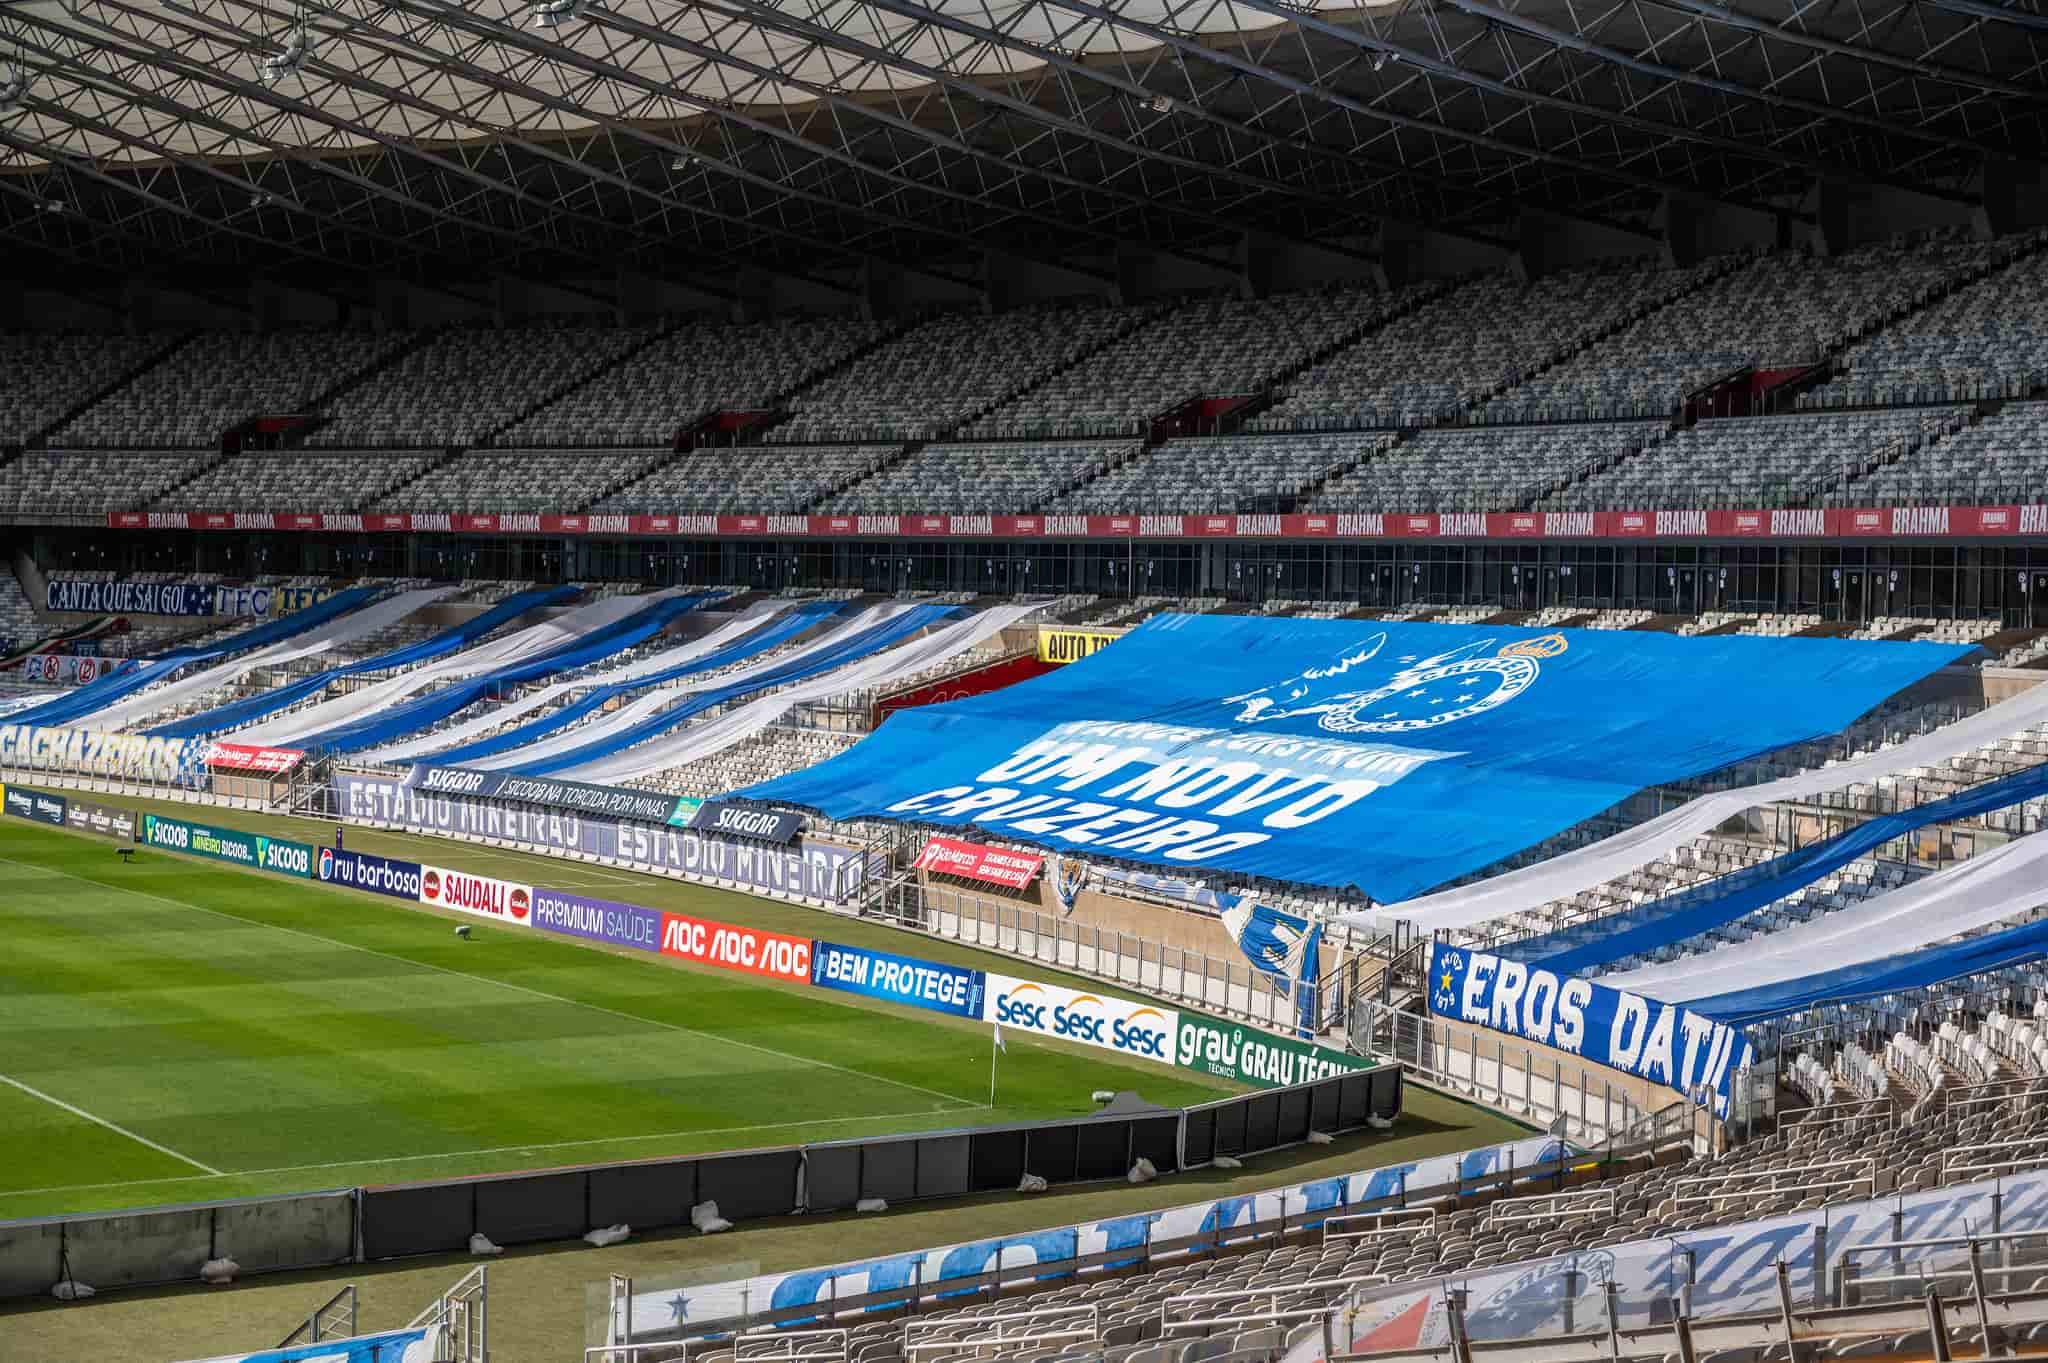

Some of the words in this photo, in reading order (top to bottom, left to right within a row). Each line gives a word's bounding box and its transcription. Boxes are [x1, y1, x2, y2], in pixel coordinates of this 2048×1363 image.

[148, 512, 190, 528] BRAHMA
[234, 512, 275, 529] BRAHMA
[322, 514, 362, 532] BRAHMA
[411, 514, 451, 531] BRAHMA
[500, 515, 540, 532] BRAHMA
[588, 515, 629, 533] BRAHMA
[678, 516, 718, 534] BRAHMA
[767, 515, 808, 534] BRAHMA
[858, 516, 900, 534] BRAHMA
[950, 515, 992, 534] BRAHMA
[1045, 515, 1088, 534] BRAHMA
[1139, 515, 1183, 535] BRAHMA
[1236, 515, 1281, 535] BRAHMA
[1337, 515, 1383, 536] BRAHMA
[1440, 514, 1487, 536] BRAHMA
[1544, 513, 1594, 536] BRAHMA
[1655, 511, 1707, 535] BRAHMA
[1771, 510, 1824, 535] BRAHMA
[1892, 507, 1949, 534] BRAHMA
[48, 582, 100, 610] CANTA
[103, 583, 133, 611] QUE
[161, 586, 187, 614] GOL
[1049, 634, 1086, 660] AUTO
[423, 769, 484, 791] SUGGAR
[975, 740, 1151, 792] UM
[1099, 755, 1382, 829] NOVO
[505, 779, 543, 798] SICOOB
[544, 784, 562, 801] NA
[563, 787, 606, 809] TORCIDA
[607, 794, 631, 811] POR
[632, 797, 668, 817] MINAS
[155, 821, 188, 848] SICOOB
[715, 808, 780, 835] SUGGAR
[885, 785, 1273, 861] CRUZEIRO
[192, 836, 220, 854] MINEIRO
[221, 840, 248, 858] SICOOB
[267, 844, 308, 873] SICOOB
[335, 859, 352, 880] rui
[357, 862, 420, 896] barbosa
[445, 875, 505, 915] SAUDALI
[606, 908, 655, 945] SAÚDE
[663, 919, 705, 957] AOC
[710, 923, 756, 967] AOC
[759, 938, 808, 977] AOC
[826, 950, 870, 985] BEM
[871, 959, 969, 1006] PROTEGE
[996, 993, 1046, 1031] Sesc
[1461, 952, 1595, 1055] EROS
[1053, 1005, 1105, 1043] Sesc
[1112, 1018, 1167, 1059] Sesc
[1178, 1023, 1237, 1066] grau
[1241, 1041, 1295, 1086] GRAU
